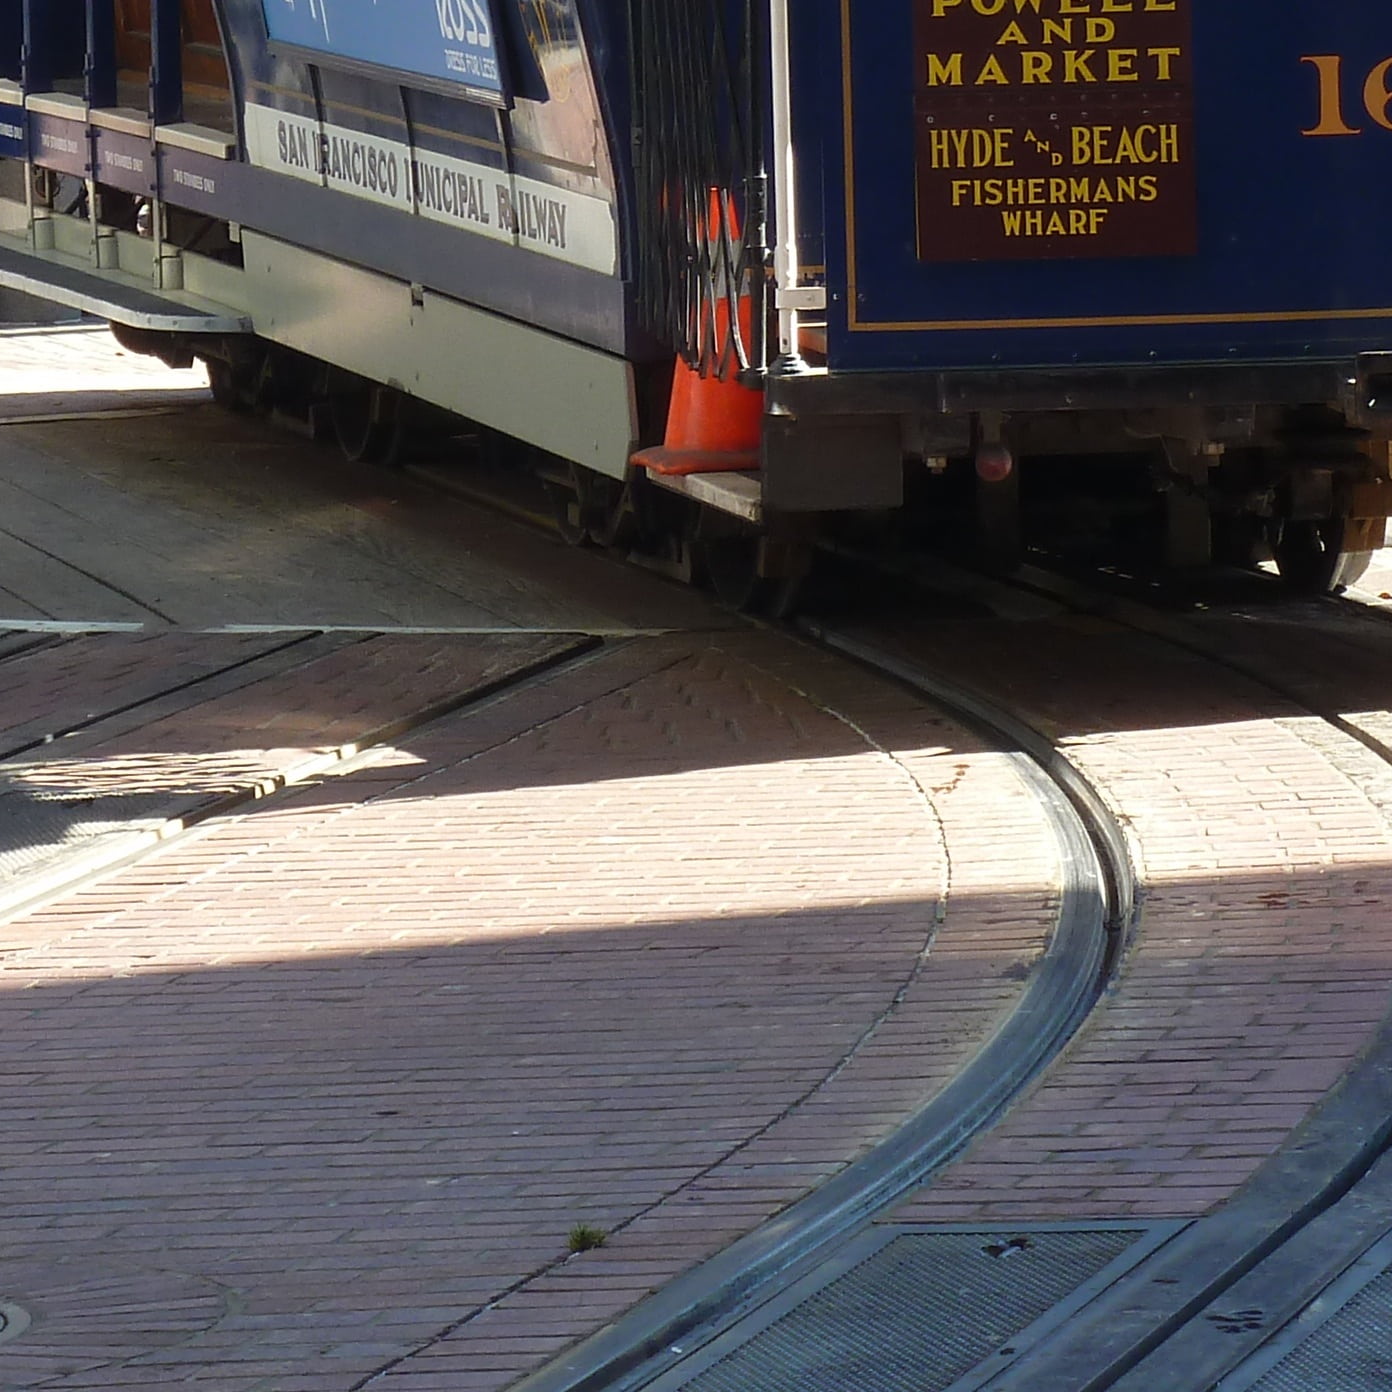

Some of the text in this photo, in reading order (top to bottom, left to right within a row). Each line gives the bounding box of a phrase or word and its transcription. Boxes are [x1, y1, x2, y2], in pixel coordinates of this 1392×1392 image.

[995, 17, 1116, 45] AND
[926, 47, 1181, 87] MARKET
[277, 120, 308, 168] SAN
[929, 124, 1180, 169] HYDE AND BEACH
[951, 176, 1158, 206] FISHERMANS
[1001, 209, 1108, 236] WHARF
